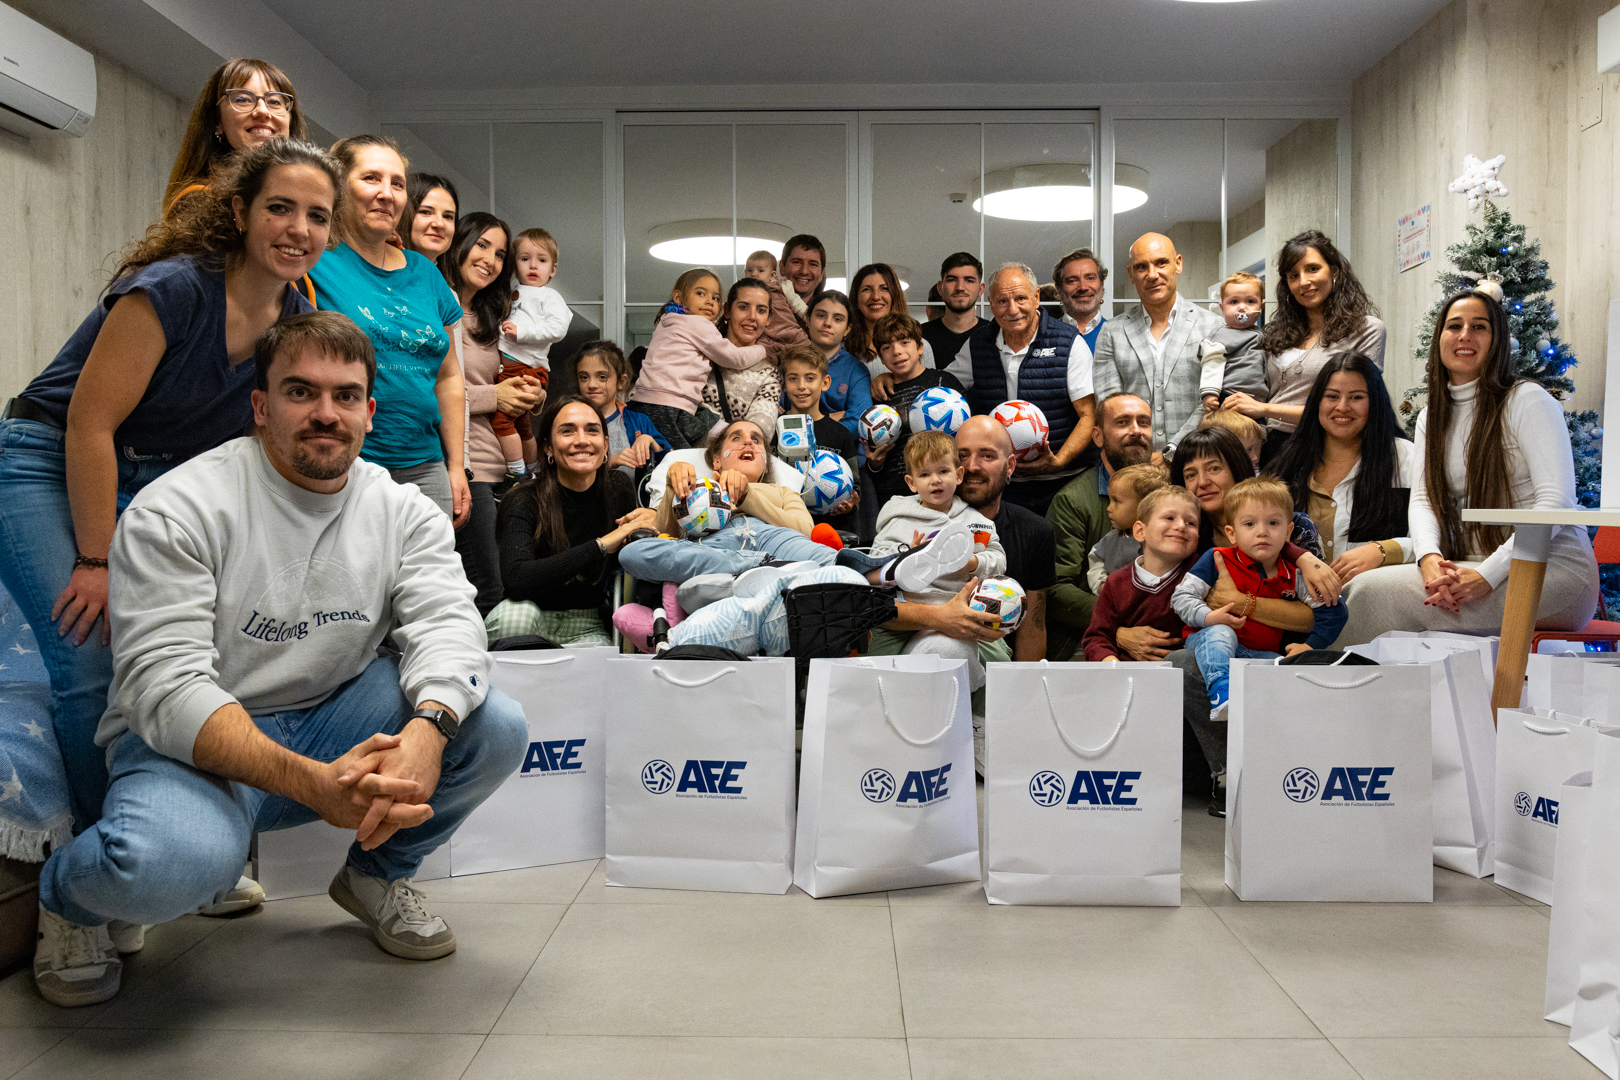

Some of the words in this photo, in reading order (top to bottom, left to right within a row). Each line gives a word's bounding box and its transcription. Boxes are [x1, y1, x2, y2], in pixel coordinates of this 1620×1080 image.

[241, 610, 309, 642] Lifelong
[312, 610, 371, 628] Trends
[520, 739, 587, 773] AFE
[676, 759, 748, 794] AFE
[895, 762, 952, 803] AFE
[1066, 770, 1142, 805] AFE
[1320, 767, 1395, 801] AFE
[1531, 796, 1560, 825] AF
